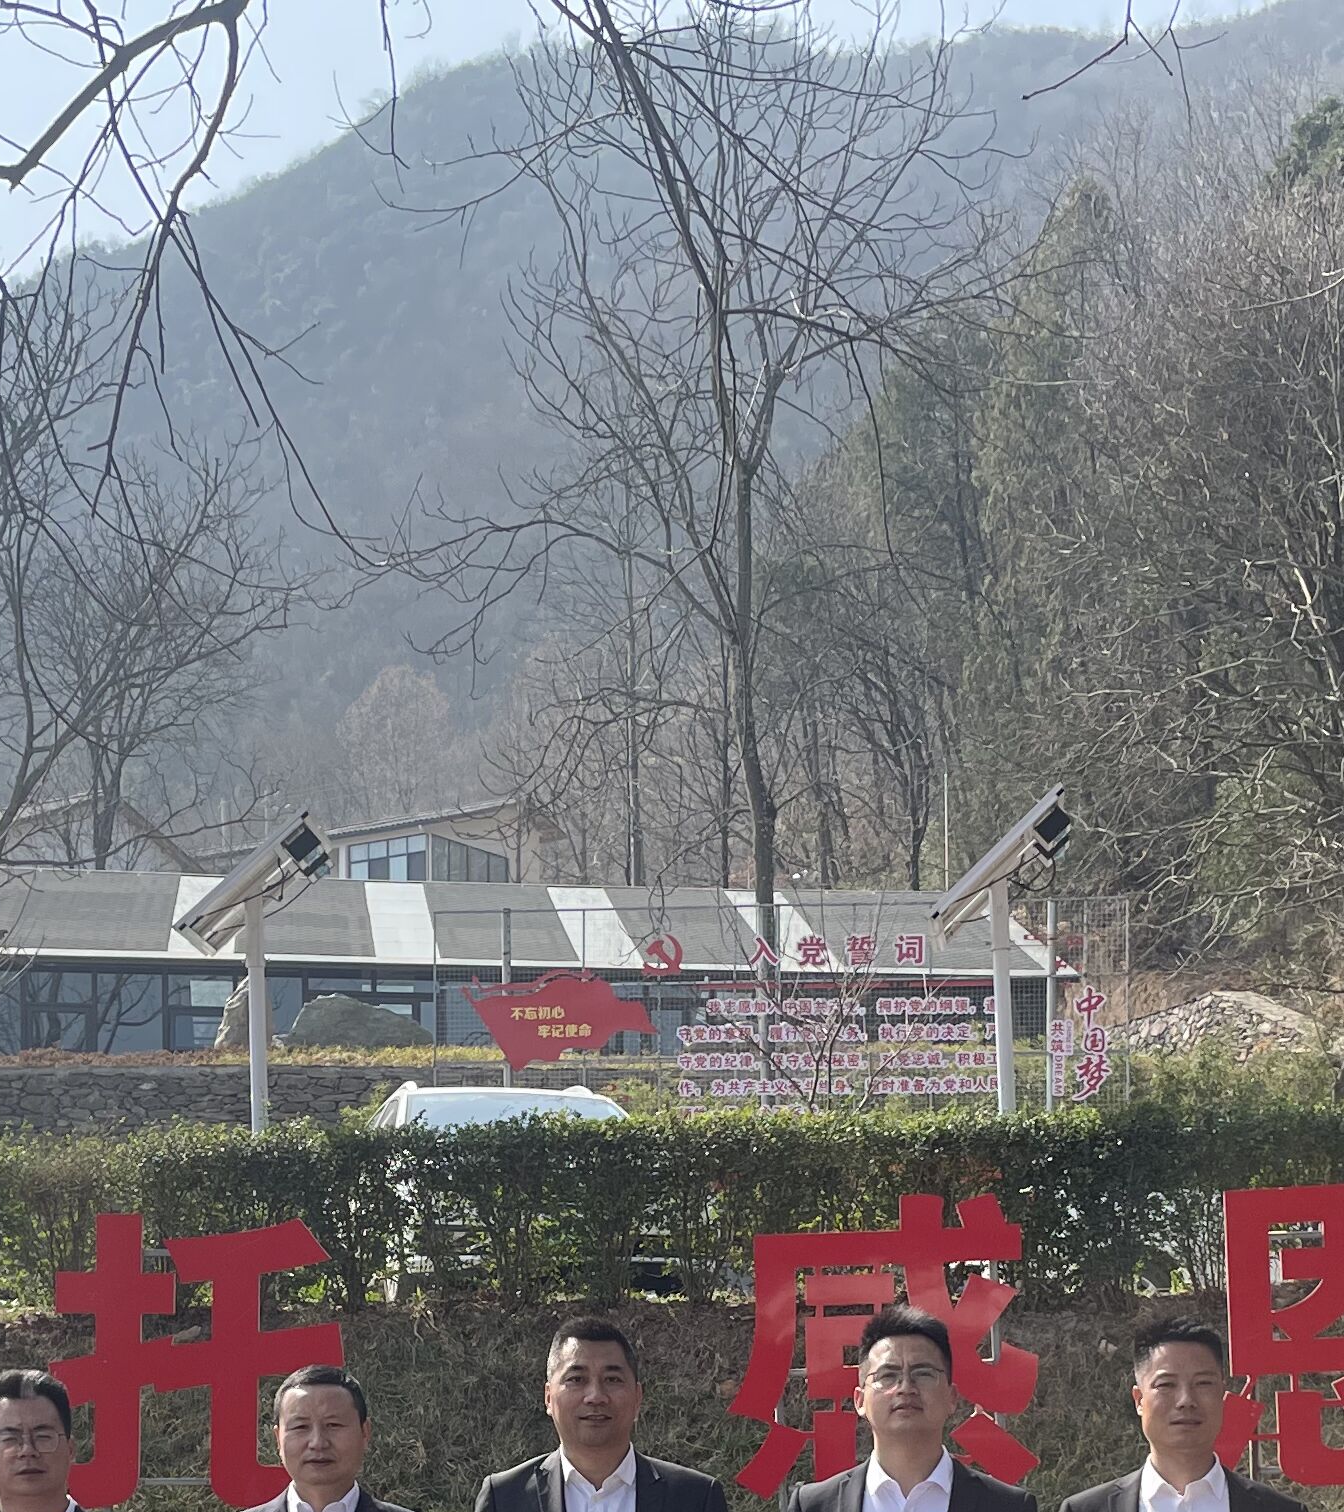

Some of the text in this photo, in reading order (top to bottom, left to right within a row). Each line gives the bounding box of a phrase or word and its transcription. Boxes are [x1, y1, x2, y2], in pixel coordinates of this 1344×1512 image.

[750, 934, 924, 966] 入党誓词
[510, 1005, 565, 1021] 不忘初心
[537, 1023, 592, 1039] 牢记使命
[1073, 987, 1110, 1099] 中国梦
[1054, 1055, 1063, 1095] DREAM
